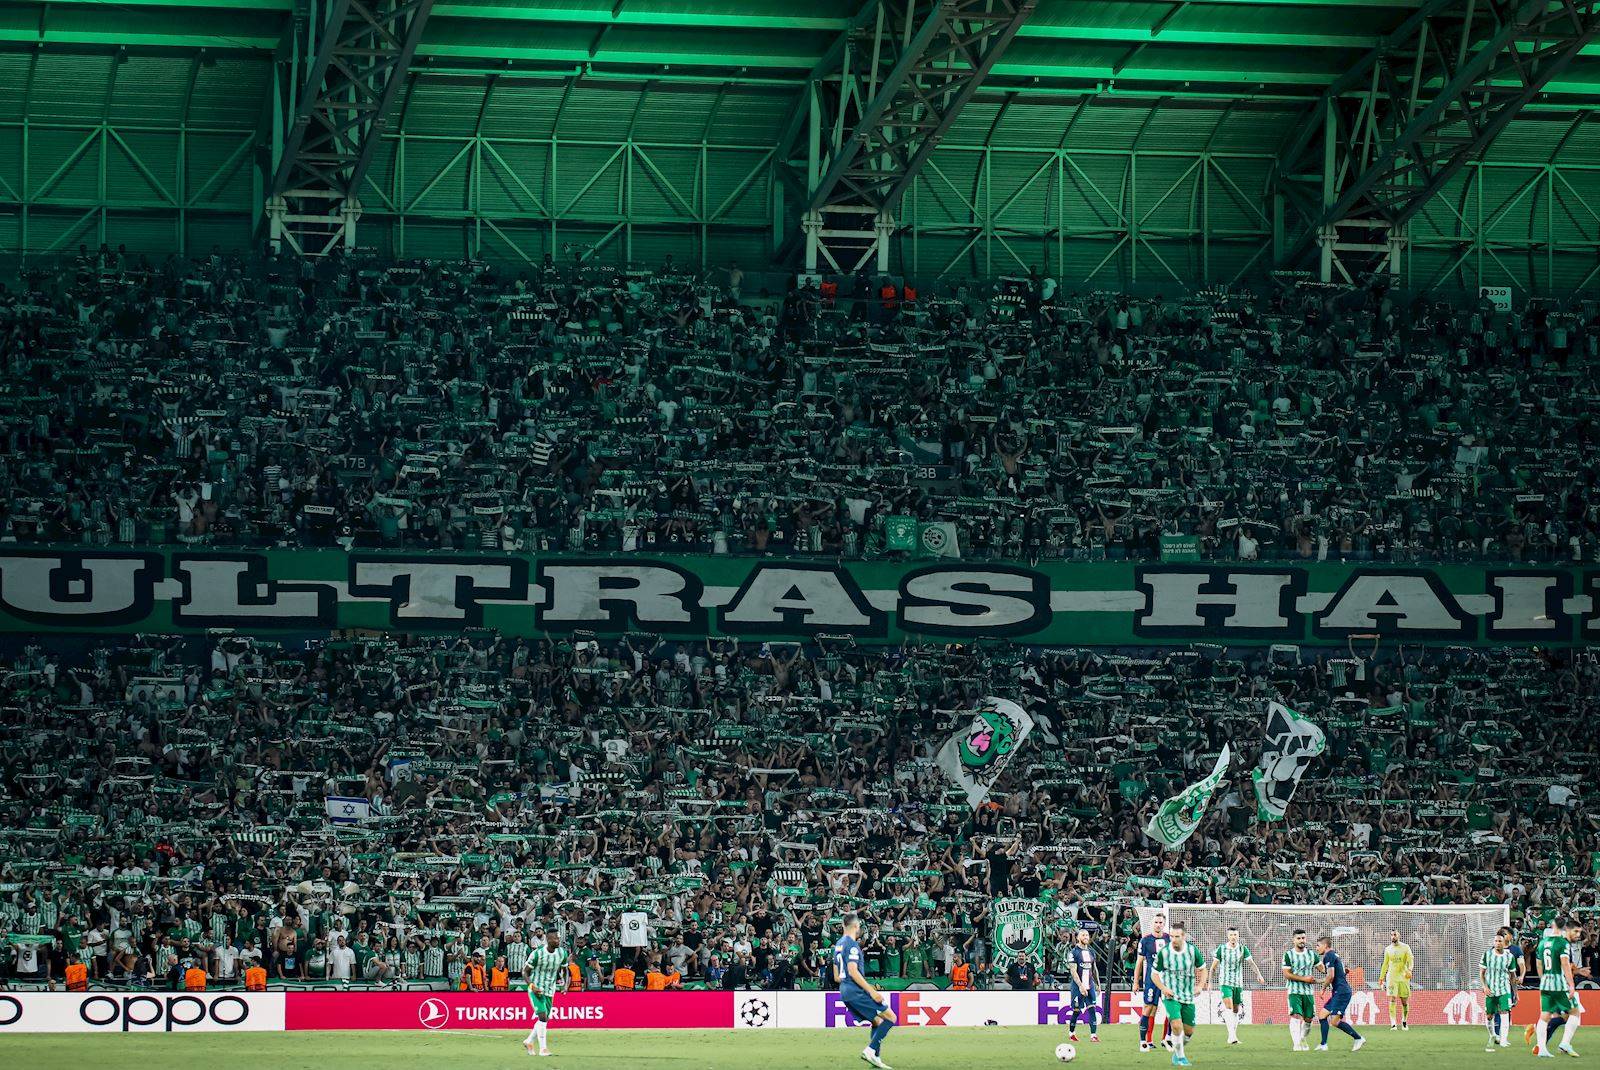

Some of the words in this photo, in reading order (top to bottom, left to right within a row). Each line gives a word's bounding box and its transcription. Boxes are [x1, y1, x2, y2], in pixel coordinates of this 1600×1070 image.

[0, 557, 1036, 628] ULTRAS
[1141, 573, 1600, 630] HAI
[998, 901, 1042, 913] ULTRAS
[1543, 948, 1552, 971] 6
[1147, 988, 1154, 997] 8
[80, 996, 249, 1031] oppo
[455, 1007, 527, 1020] TURKISH
